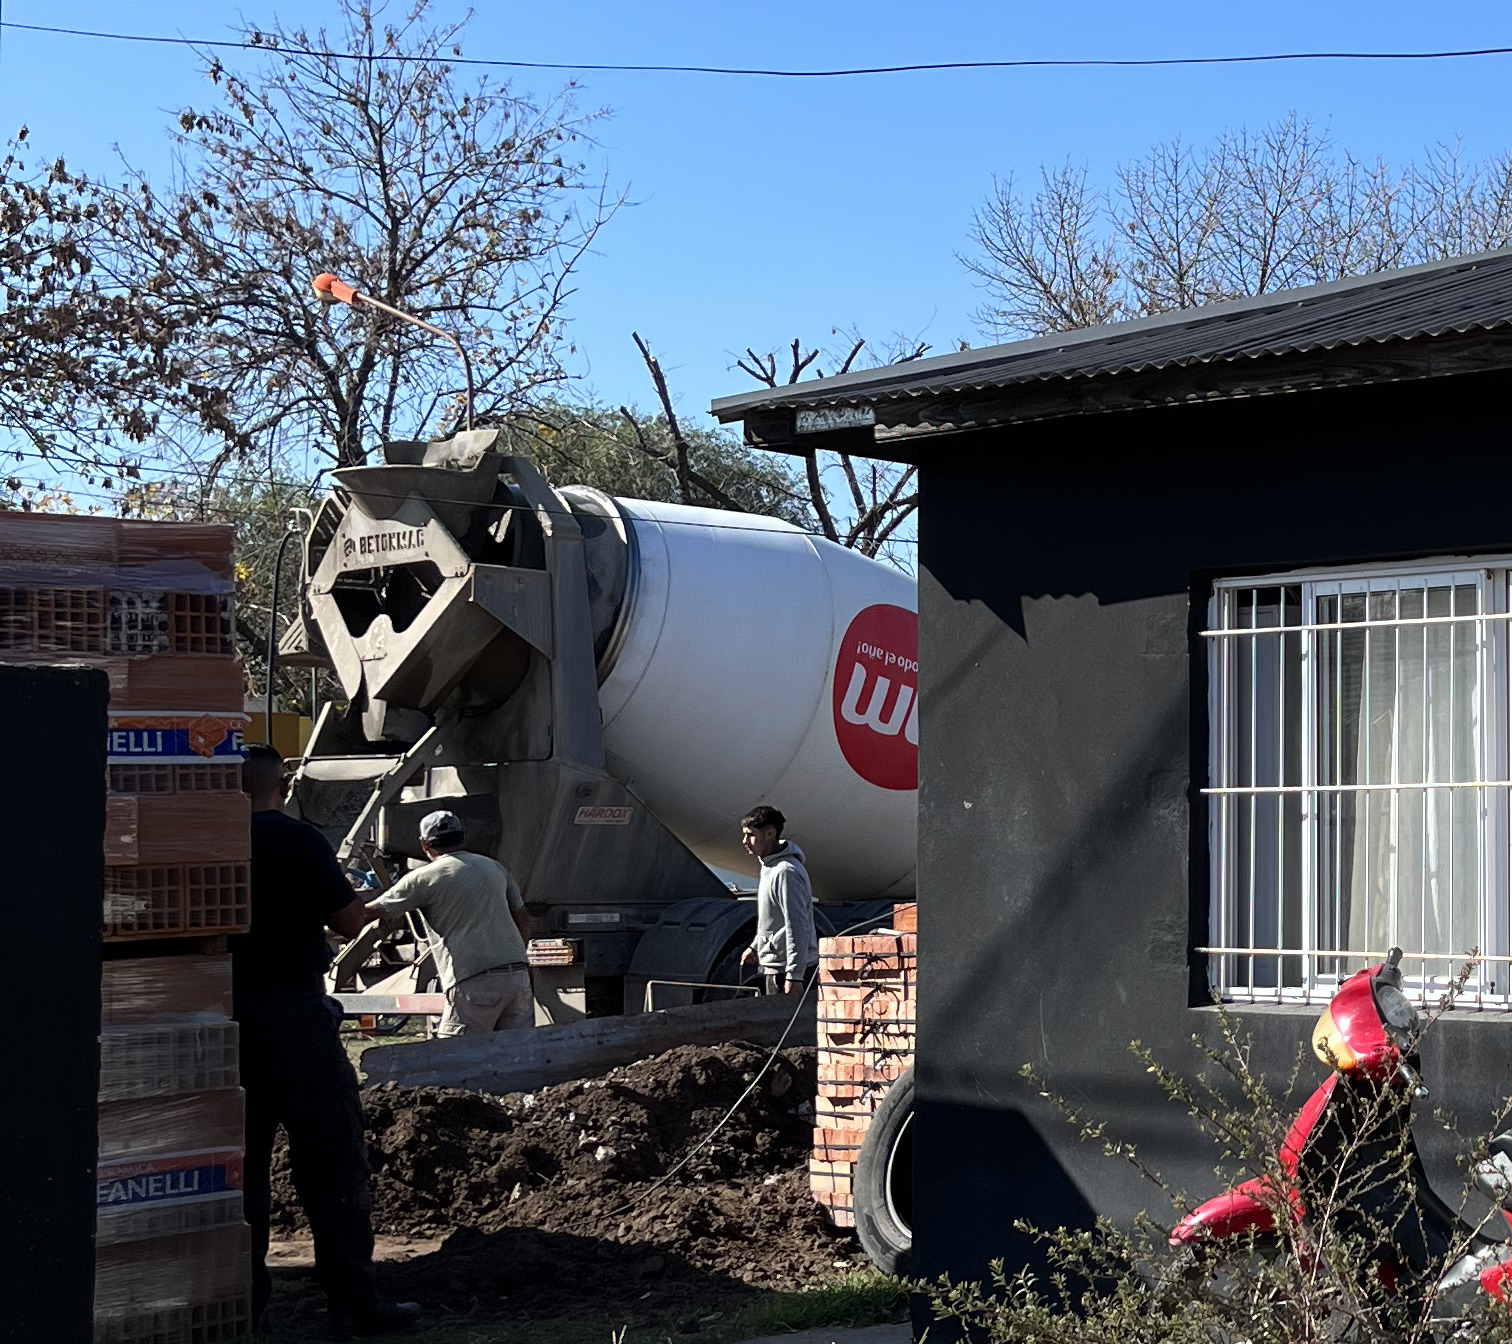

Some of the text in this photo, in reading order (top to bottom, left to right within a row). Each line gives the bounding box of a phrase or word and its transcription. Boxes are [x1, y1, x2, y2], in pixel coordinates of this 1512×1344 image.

[857, 641, 918, 673] odo el año!
[107, 731, 162, 752] ELLI
[97, 1170, 199, 1203] FANELLI
